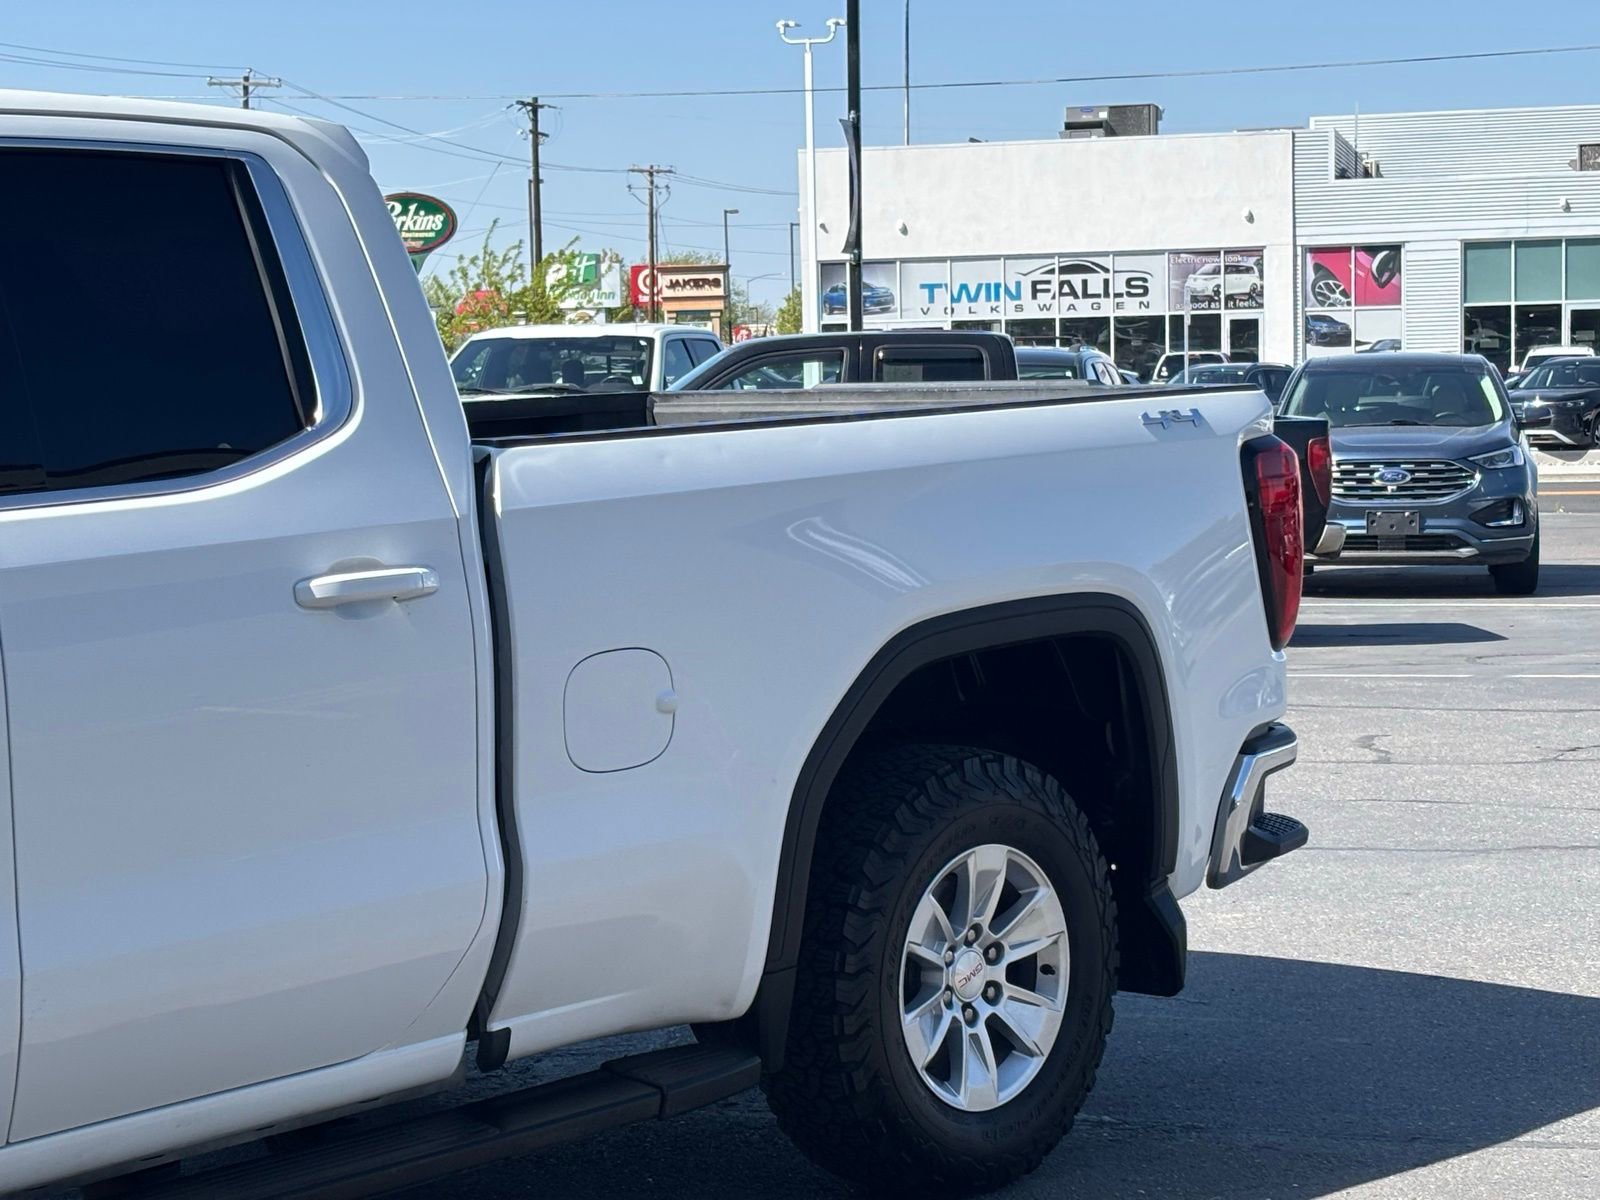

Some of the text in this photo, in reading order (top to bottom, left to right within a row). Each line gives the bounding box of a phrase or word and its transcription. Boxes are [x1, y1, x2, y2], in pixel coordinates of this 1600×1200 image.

[385, 201, 444, 231] Prkins
[919, 276, 1150, 304] TWIN FALLS
[920, 300, 1150, 316] VOLKSWAGEN
[1189, 301, 1208, 309] ood
[957, 962, 983, 988] GMC
